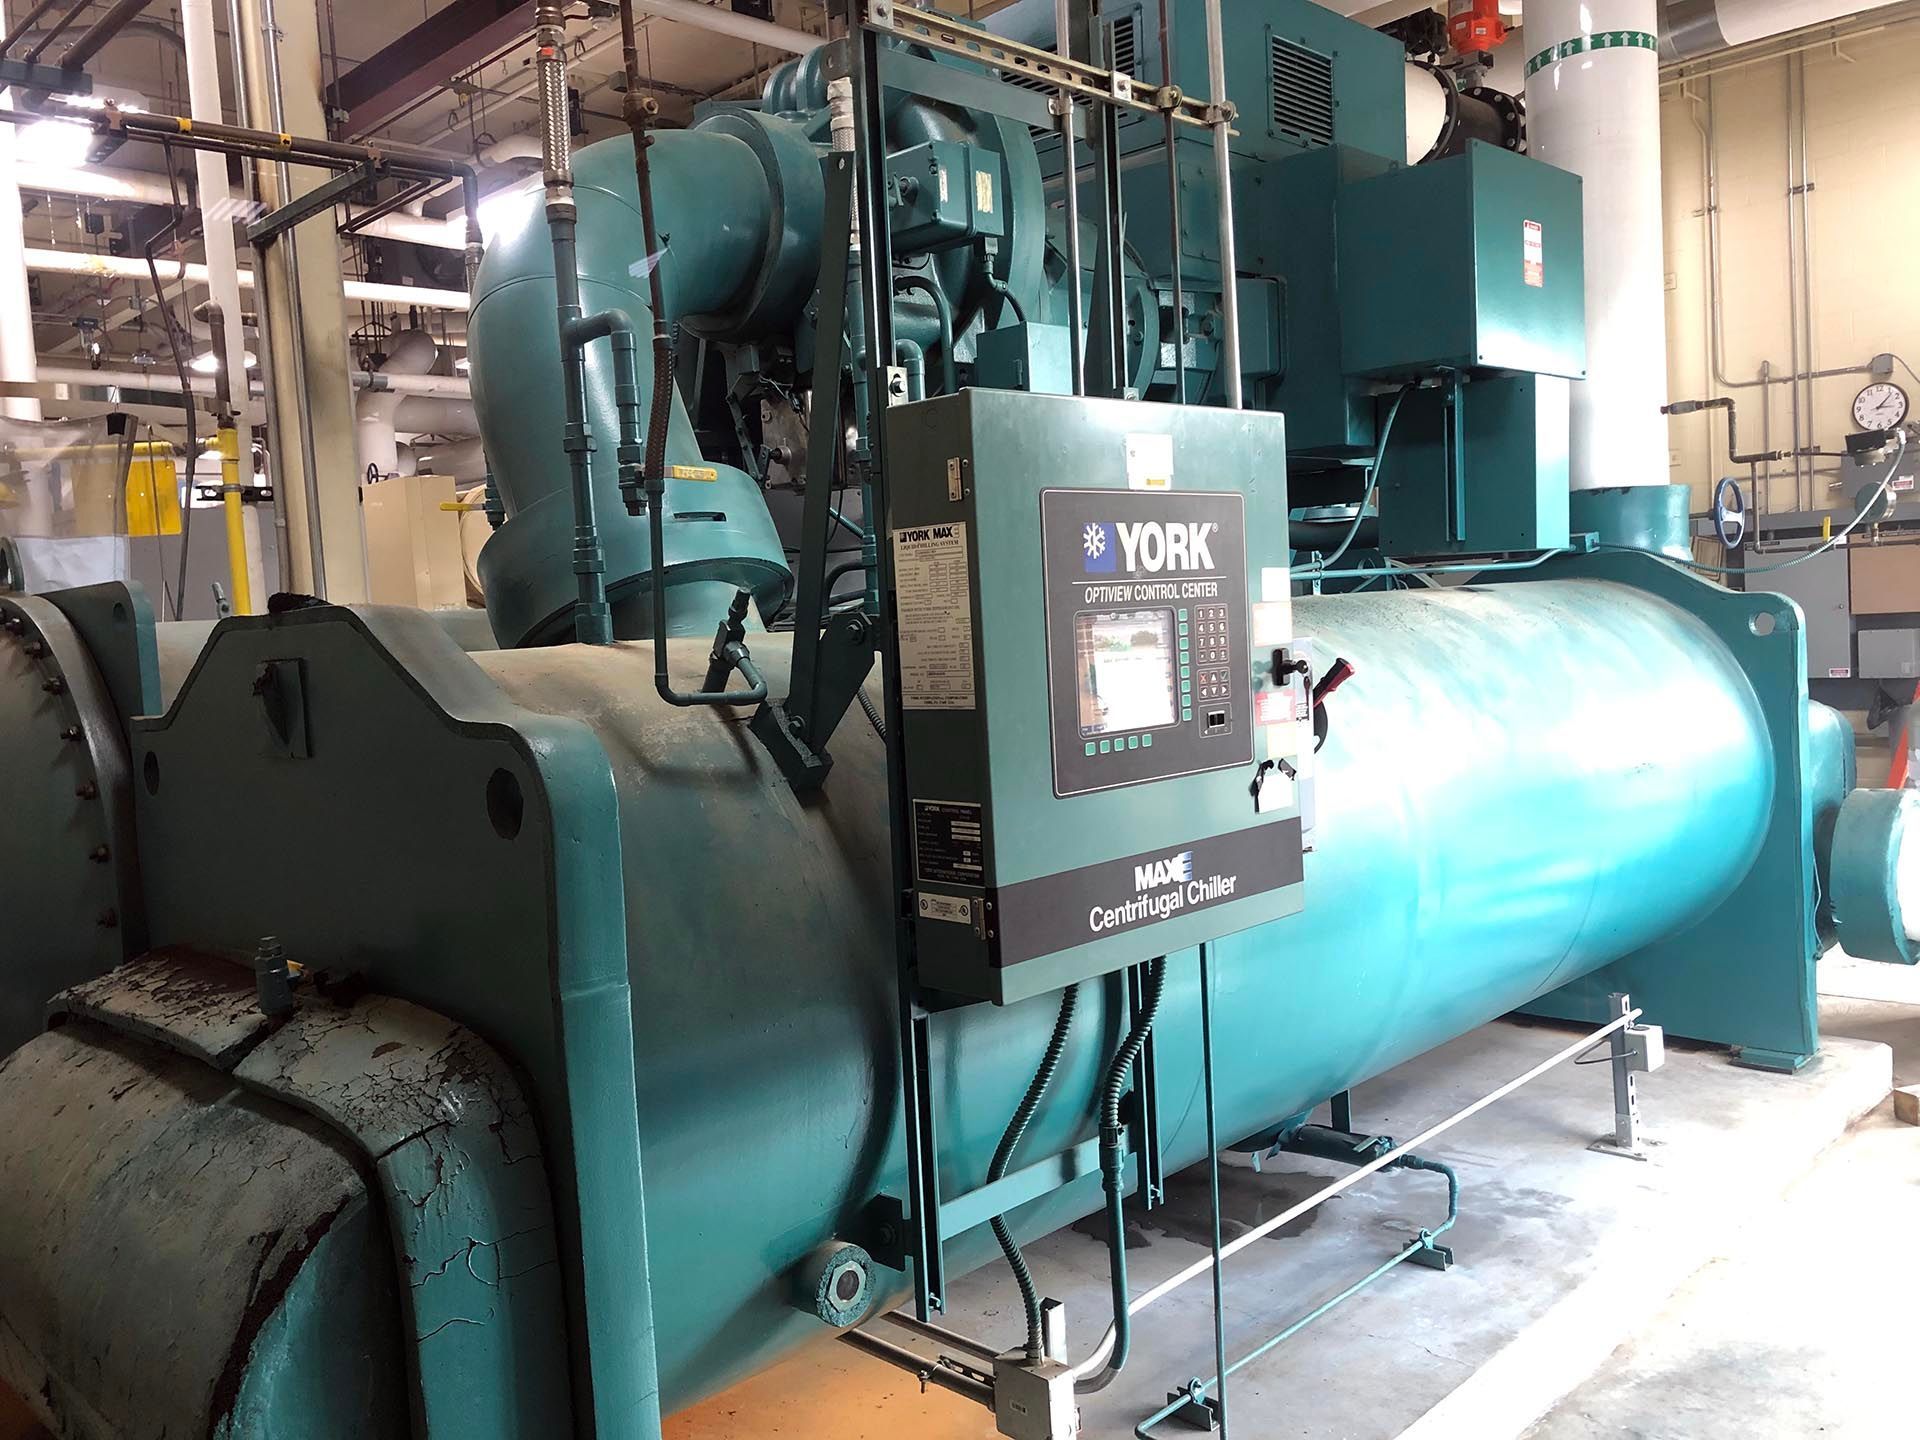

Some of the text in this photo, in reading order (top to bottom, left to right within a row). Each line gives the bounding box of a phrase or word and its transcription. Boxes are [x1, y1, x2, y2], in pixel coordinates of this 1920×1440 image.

[907, 529, 930, 542] YORK
[1085, 582, 1218, 604] OPTIVIEW CONTROL CENTER
[1200, 608, 1224, 618] 1 2 3
[1199, 622, 1225, 632] 4 5 6
[1200, 636, 1225, 646] 7 8 9
[1210, 651, 1216, 660] 0
[1089, 874, 1237, 932] Centrifugal Chiller
